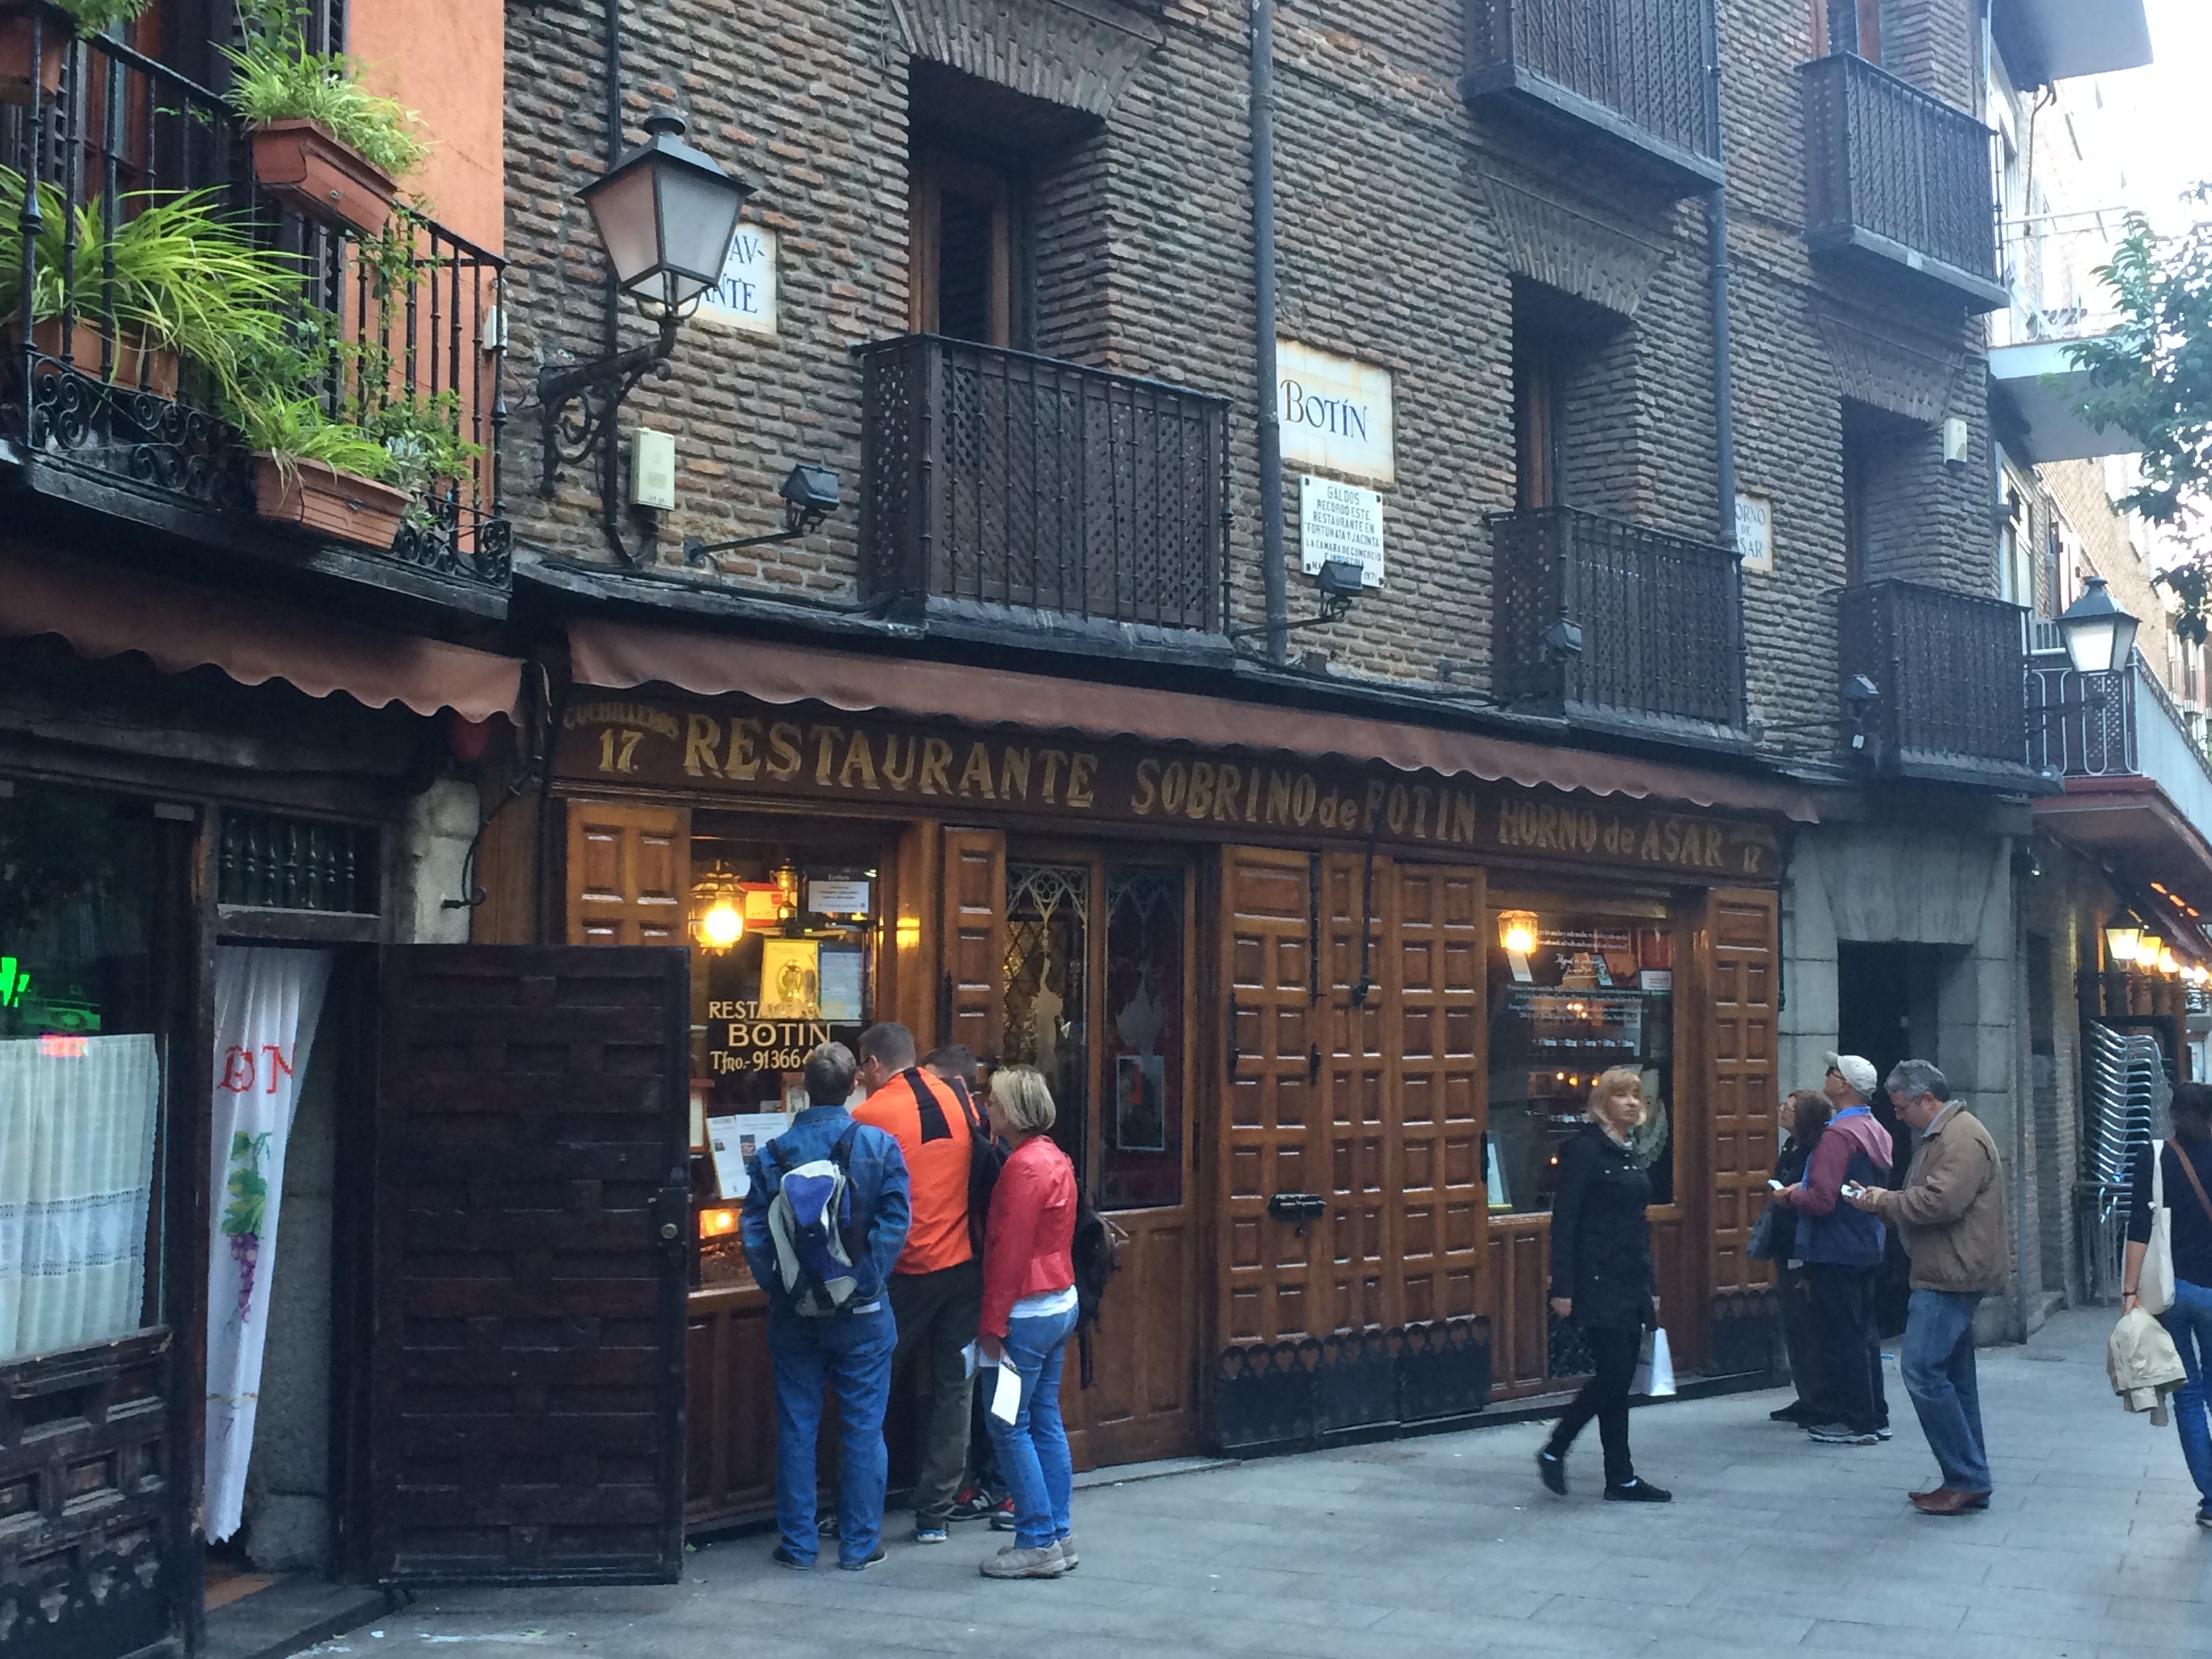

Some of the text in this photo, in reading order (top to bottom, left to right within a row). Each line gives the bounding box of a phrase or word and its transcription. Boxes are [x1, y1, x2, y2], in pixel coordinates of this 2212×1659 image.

[1280, 380, 1368, 443] BOTÍN
[1313, 511, 1374, 534] RESTAURANTE EN
[1351, 507, 1370, 520] ESTE
[1347, 532, 1351, 541] Y
[1740, 525, 1751, 536] DE
[1306, 538, 1315, 548] LA
[1342, 545, 1350, 554] DE
[683, 714, 1099, 807] RESTAURANTE
[1131, 758, 1316, 827] SOBRINO
[1319, 785, 1357, 831] de
[1498, 798, 1597, 853] HORNO
[1603, 816, 1635, 855] de
[1640, 818, 1723, 867] ASAR
[729, 1023, 831, 1046] BOTIN
